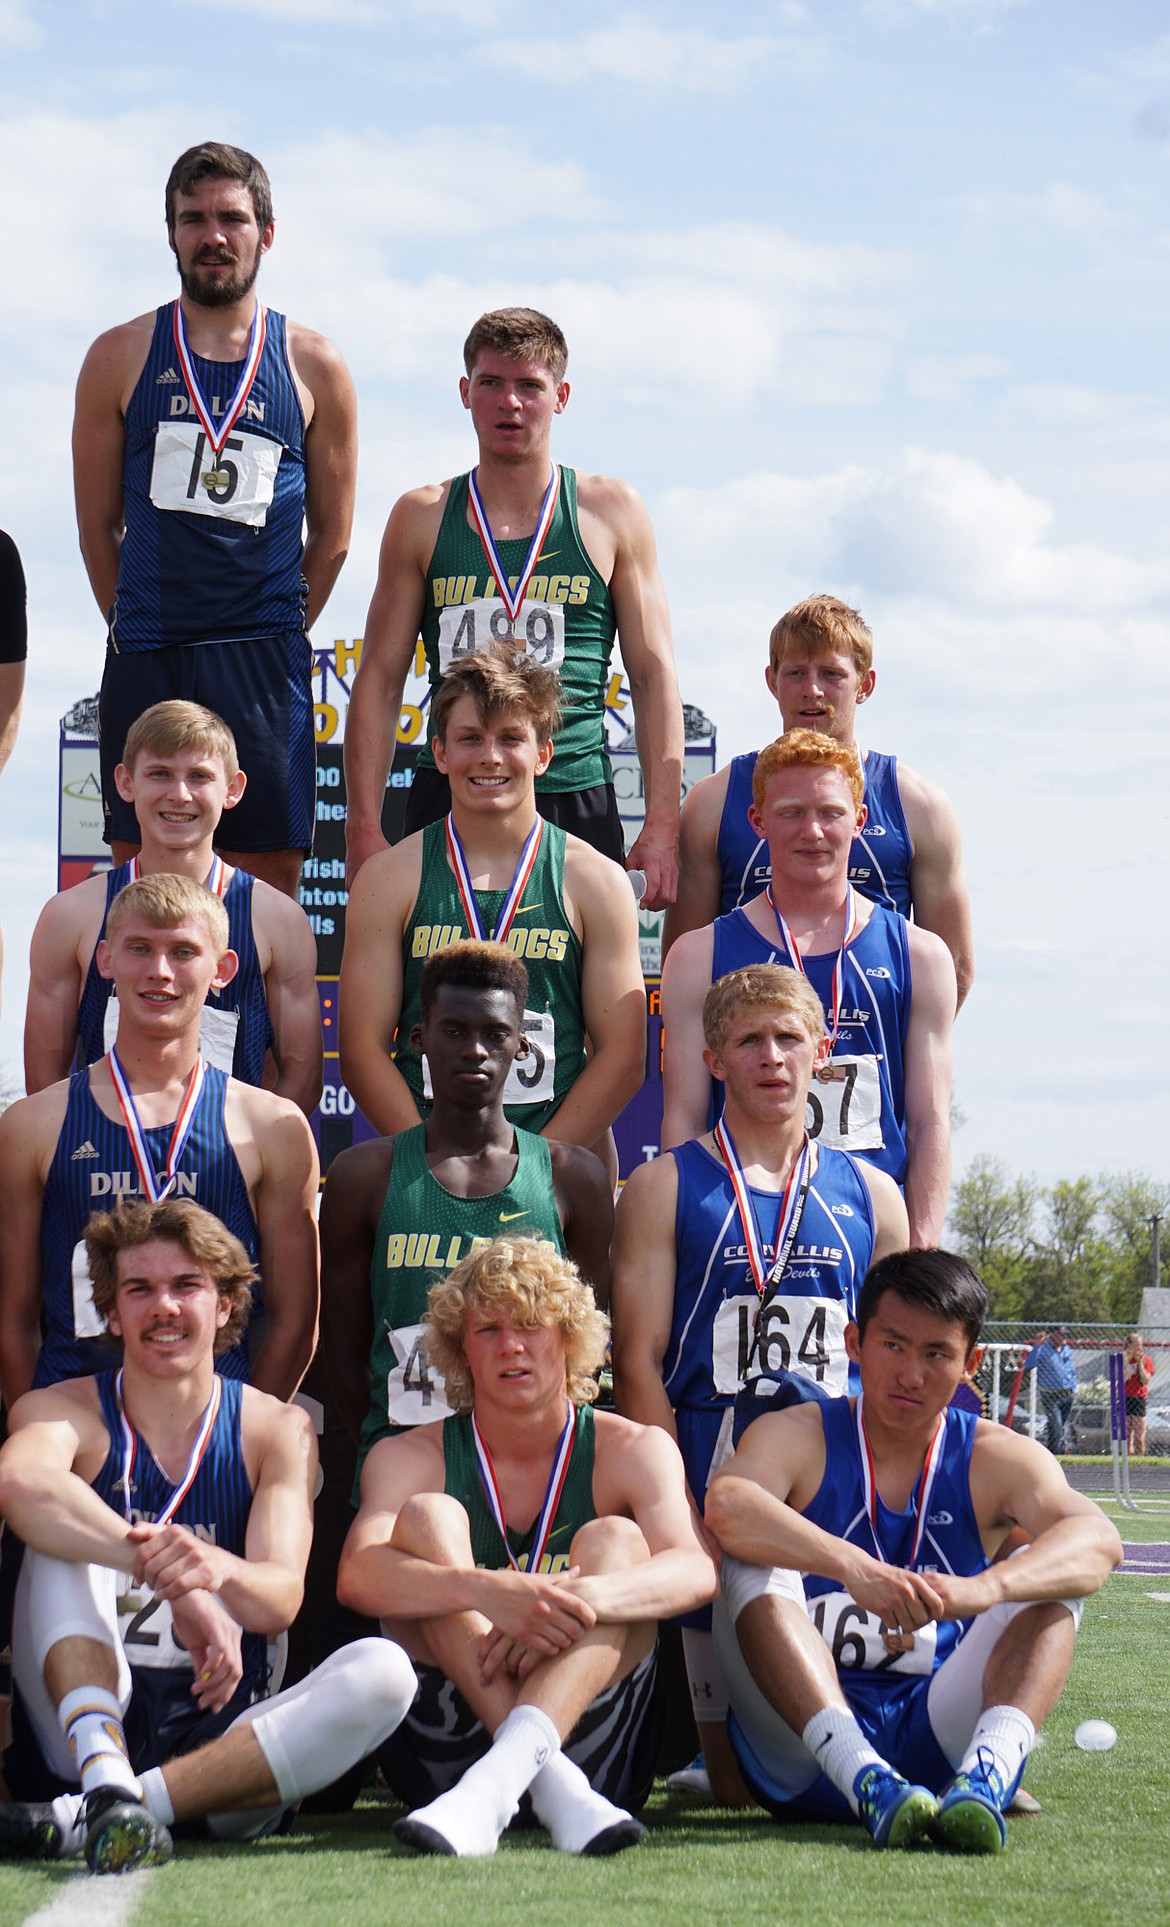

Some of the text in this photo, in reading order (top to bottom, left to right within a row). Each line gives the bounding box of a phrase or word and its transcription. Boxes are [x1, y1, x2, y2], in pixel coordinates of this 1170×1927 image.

[155, 377, 181, 385] adidas
[169, 394, 266, 423] DILON
[186, 432, 244, 505] 15
[411, 924, 569, 961] BUOGS
[71, 1151, 100, 1160] adidas
[90, 1171, 198, 1196] DILON
[723, 1244, 844, 1261] COVLLIS
[772, 1239, 793, 1284] NATIONAL
[738, 1304, 830, 1382] 164
